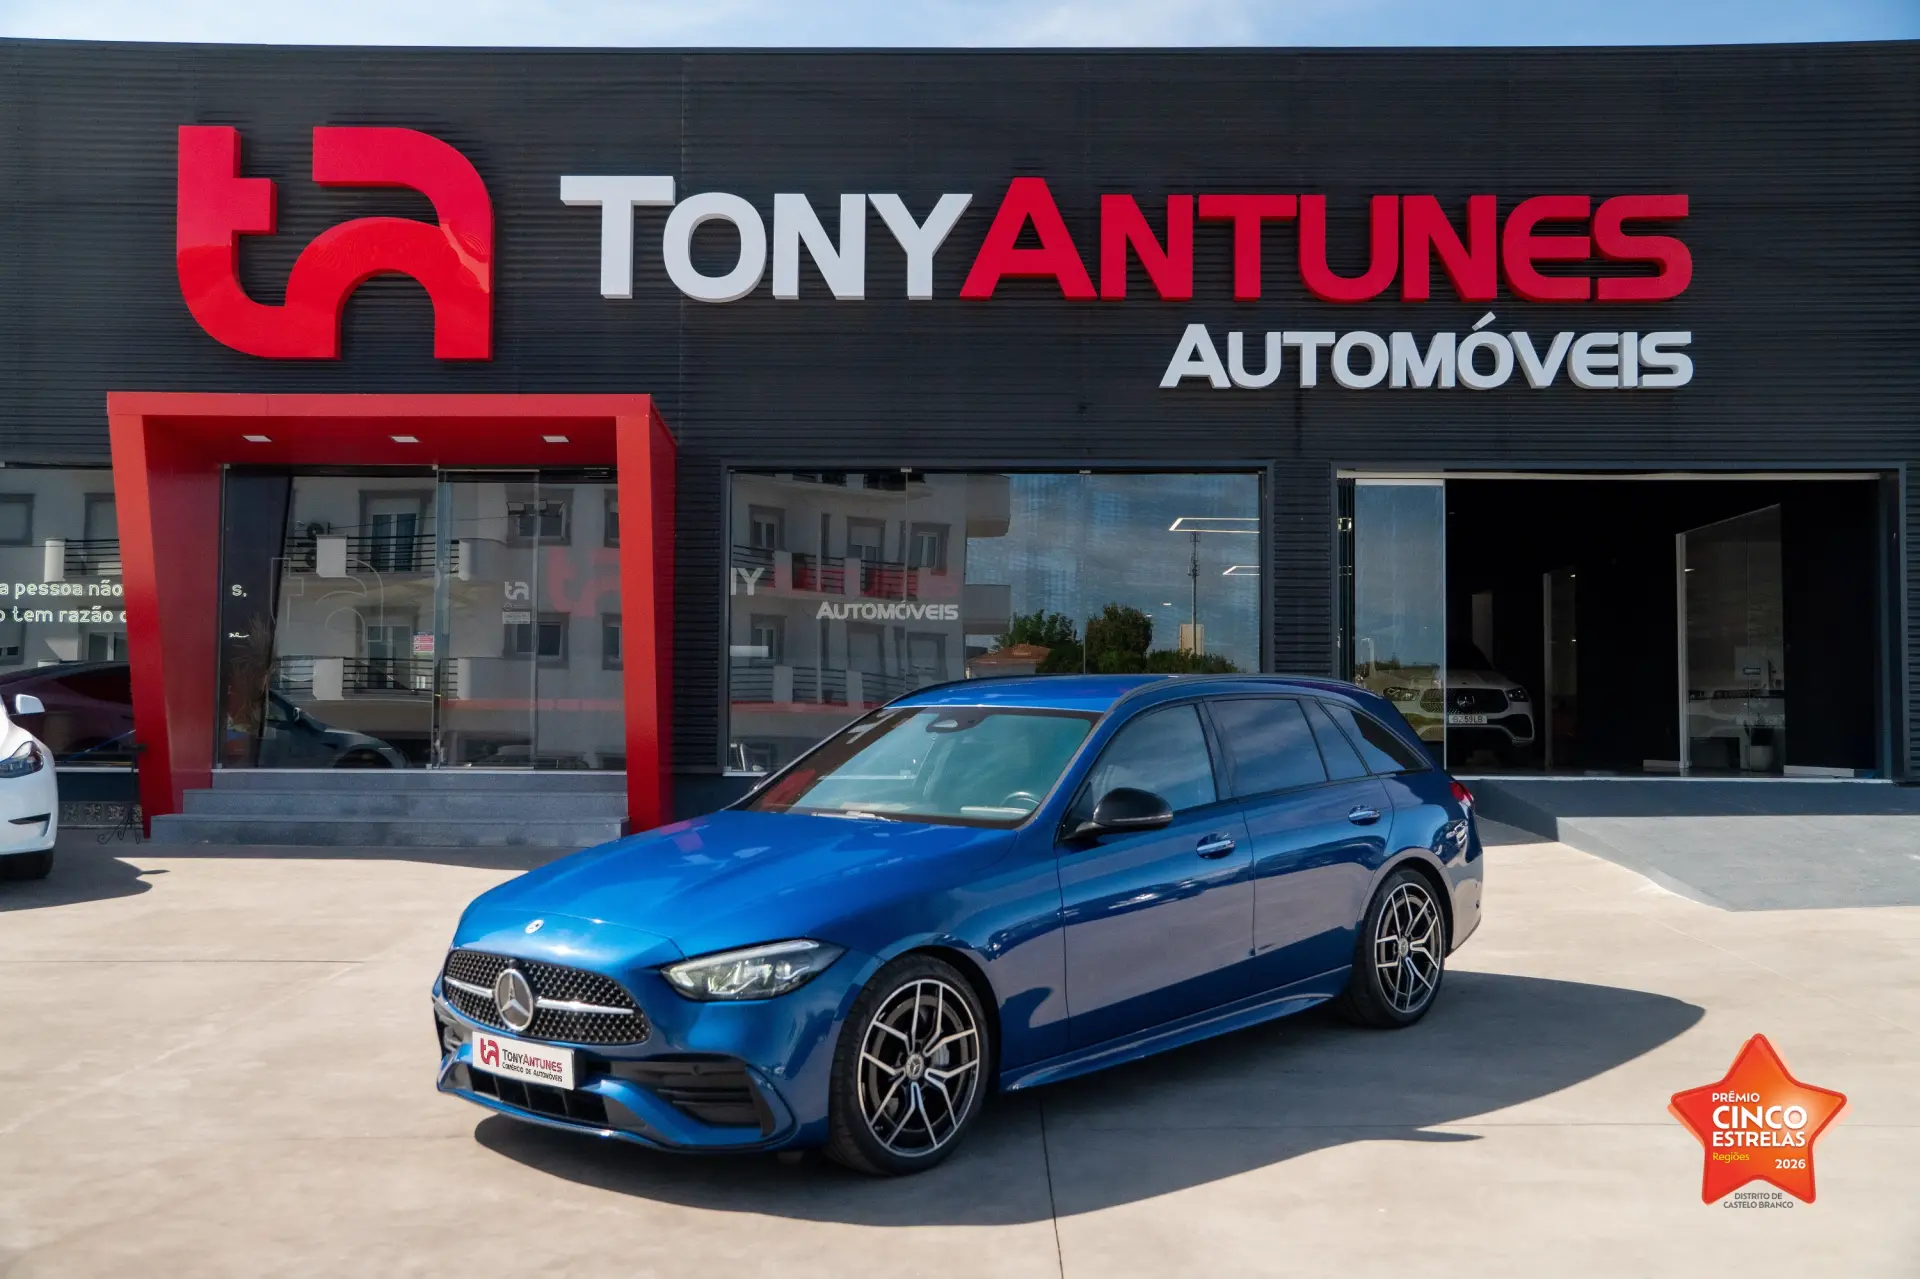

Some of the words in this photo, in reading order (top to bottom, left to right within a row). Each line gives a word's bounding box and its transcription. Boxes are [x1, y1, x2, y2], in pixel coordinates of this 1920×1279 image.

[1159, 311, 1694, 390] AUTOMÓVEIS
[14, 583, 83, 600] pessoa
[88, 579, 123, 597] não
[12, 605, 53, 622] tem
[59, 605, 114, 623] razão
[815, 600, 959, 621] AUTOMÓVEIS
